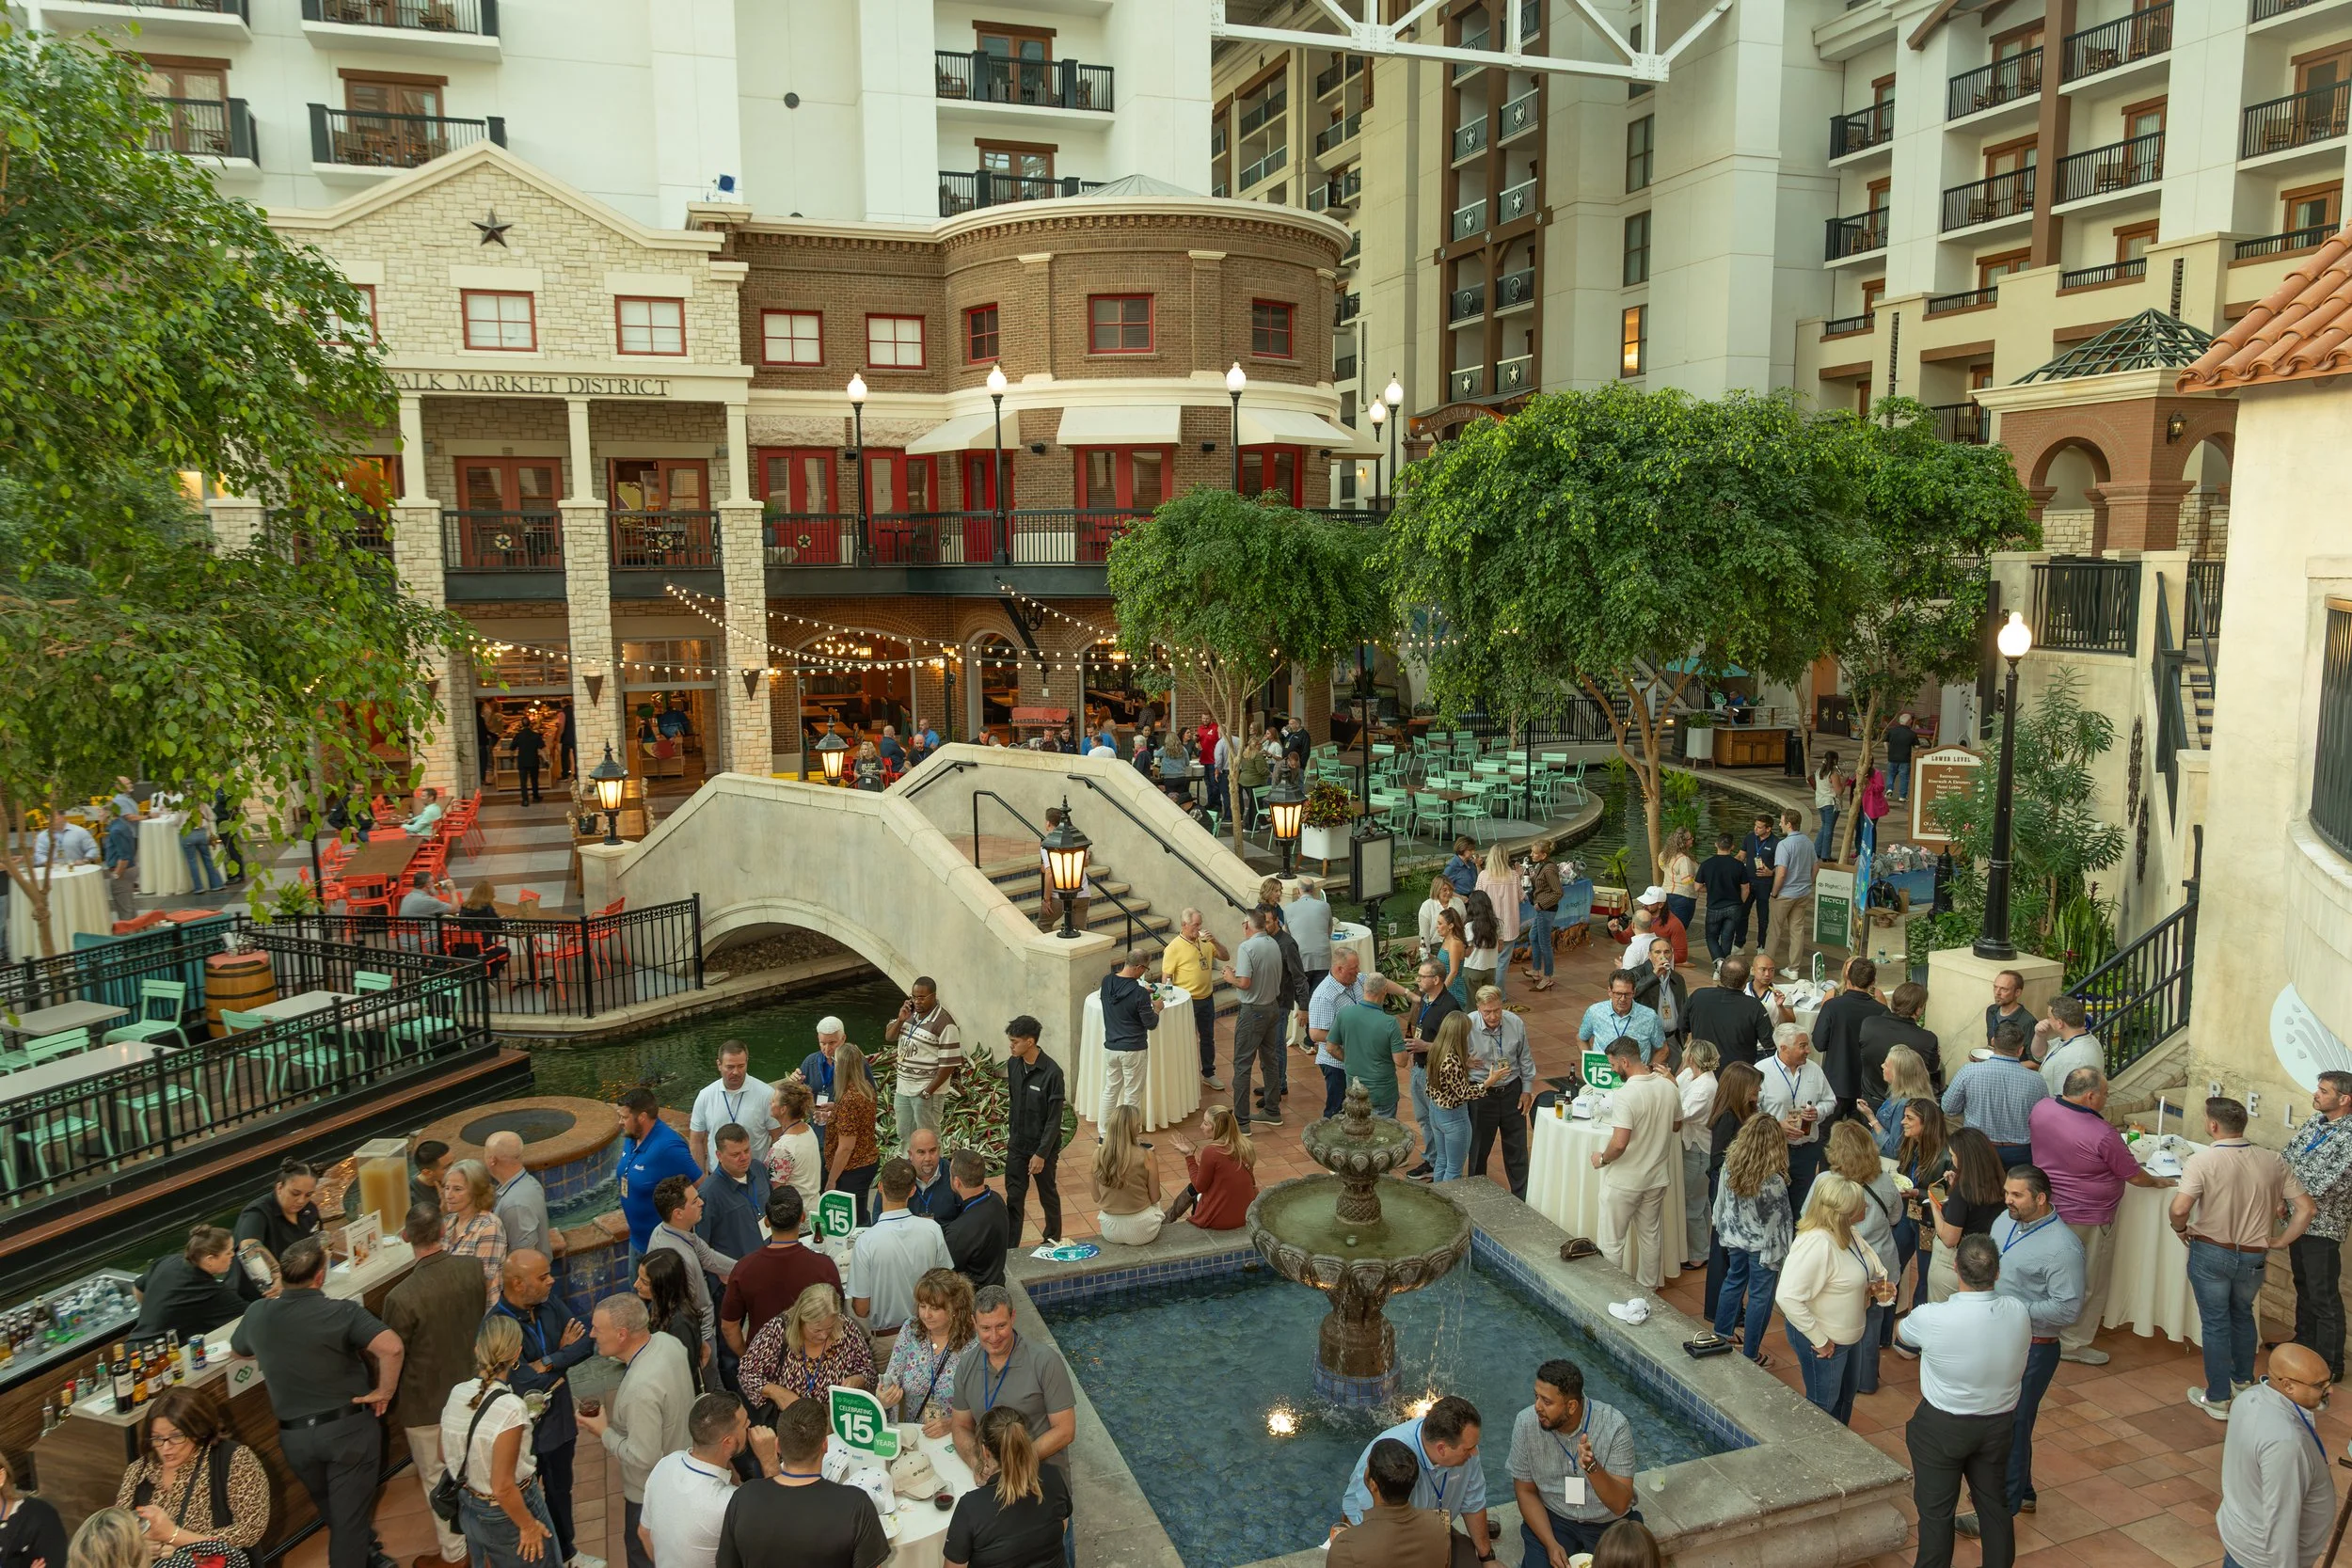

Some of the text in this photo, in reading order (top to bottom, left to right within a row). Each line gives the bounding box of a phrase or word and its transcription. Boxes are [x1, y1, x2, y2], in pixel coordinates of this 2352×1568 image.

[455, 374, 558, 394] MARKET
[566, 376, 670, 396] DISTRICT
[1428, 411, 1450, 428] LONE
[1451, 407, 1470, 420] STAR
[1820, 896, 1847, 906] RECYCLE
[1588, 1067, 1613, 1085] 15
[825, 1202, 849, 1212] CELEBRATING
[826, 1209, 850, 1234] 15
[838, 1404, 873, 1416] CELEBRATING
[839, 1413, 874, 1444] 15
[875, 1438, 896, 1448] YEARS
